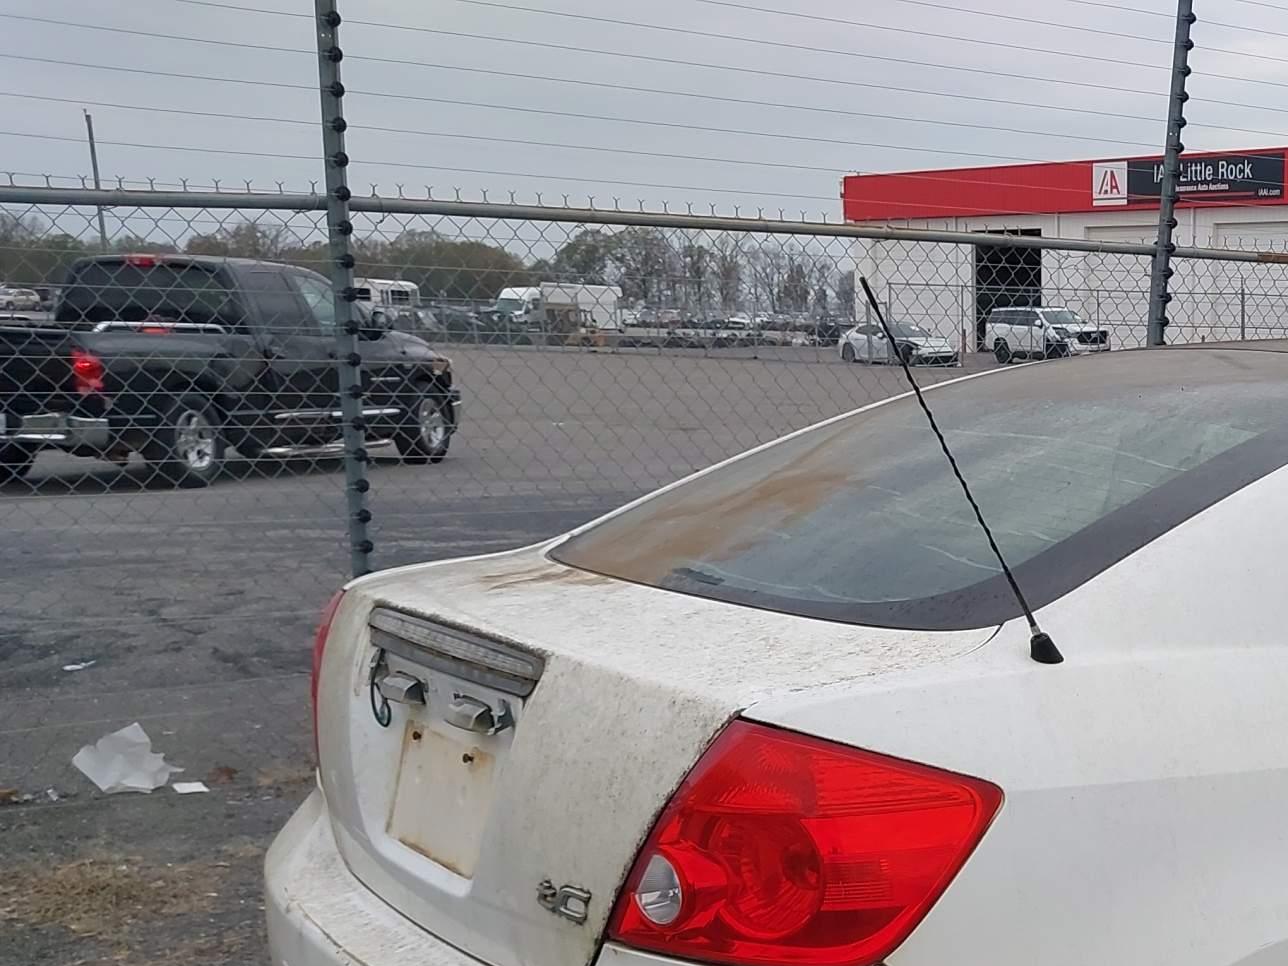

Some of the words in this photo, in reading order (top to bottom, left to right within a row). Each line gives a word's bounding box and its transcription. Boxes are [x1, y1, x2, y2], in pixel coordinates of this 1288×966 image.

[1180, 162, 1213, 182] Little
[1218, 159, 1253, 180] Rock
[1198, 183, 1209, 191] Auto
